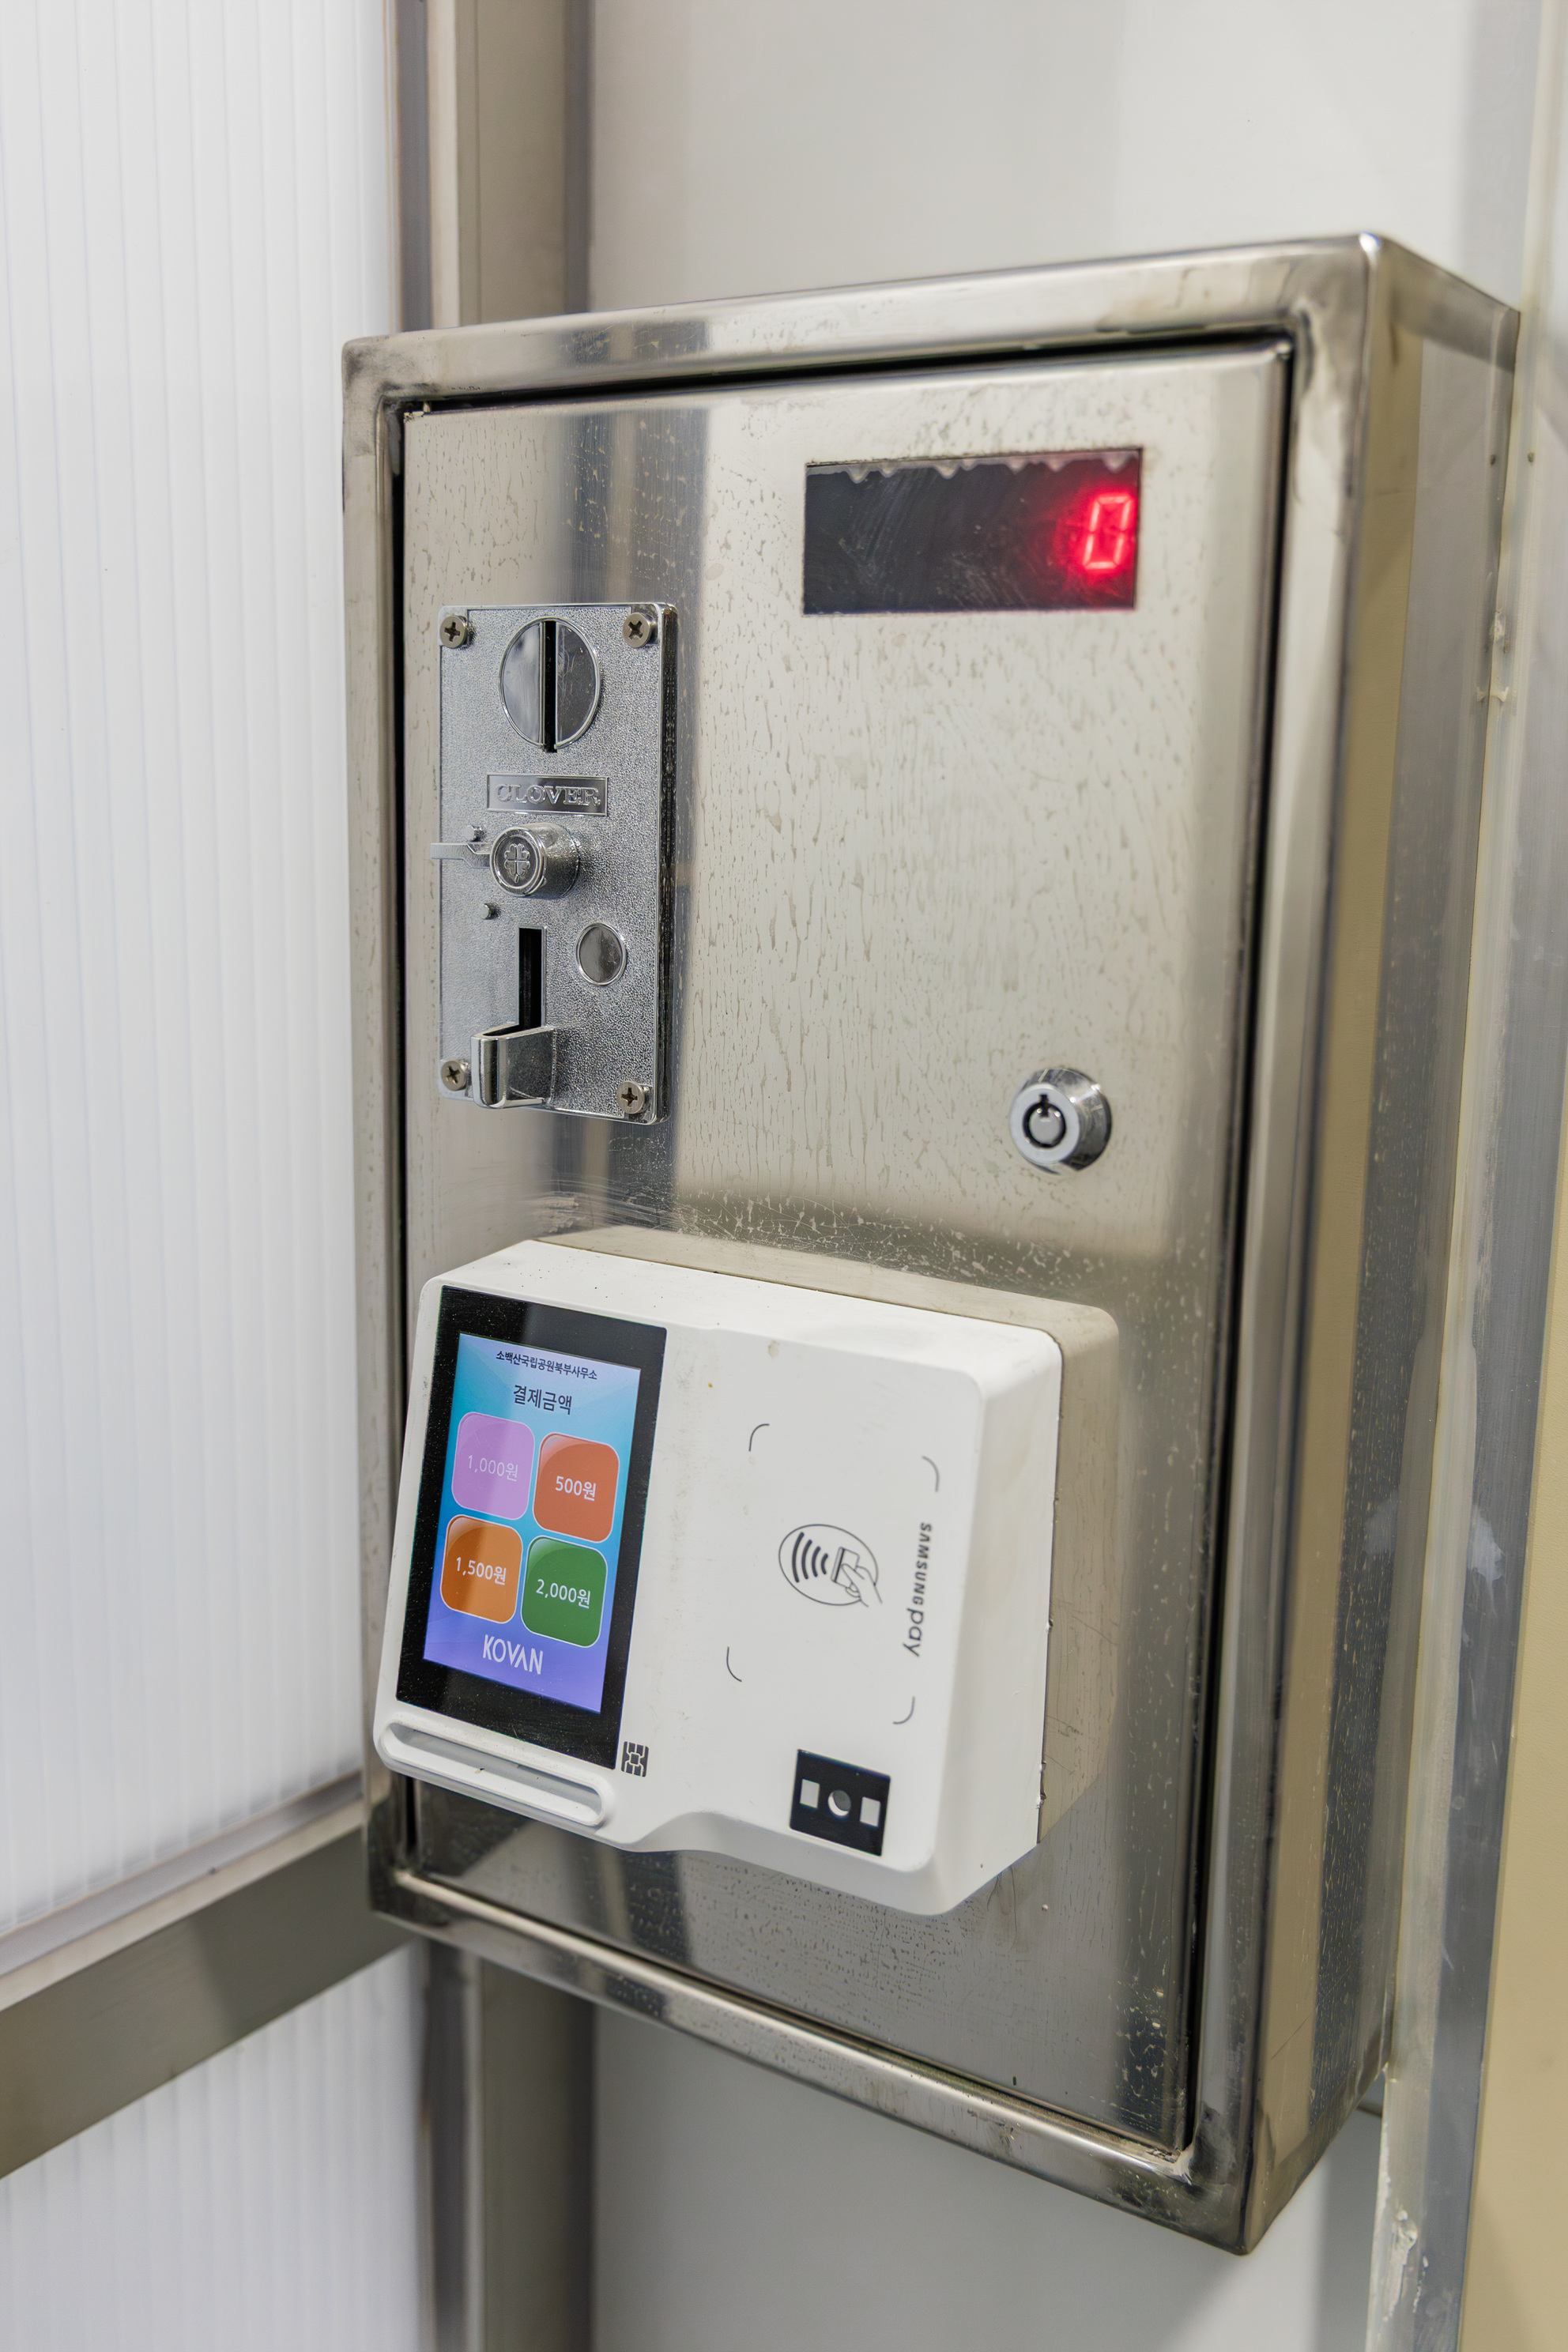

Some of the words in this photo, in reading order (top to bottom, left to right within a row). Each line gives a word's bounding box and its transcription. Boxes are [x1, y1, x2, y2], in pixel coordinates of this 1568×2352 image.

[1082, 494, 1134, 571] 0
[496, 783, 601, 807] CLOVER
[496, 1350, 598, 1380] 소백산국립공원북부사무소
[513, 1384, 573, 1415] 결제금액
[467, 1454, 518, 1482] 1,000원
[554, 1475, 597, 1502] 500원
[455, 1556, 507, 1586] 1,500원
[912, 1521, 933, 1606] SAMSUNG
[535, 1578, 591, 1609] 2,000원
[902, 1607, 925, 1657] pay
[482, 1634, 544, 1675] KOVAN
